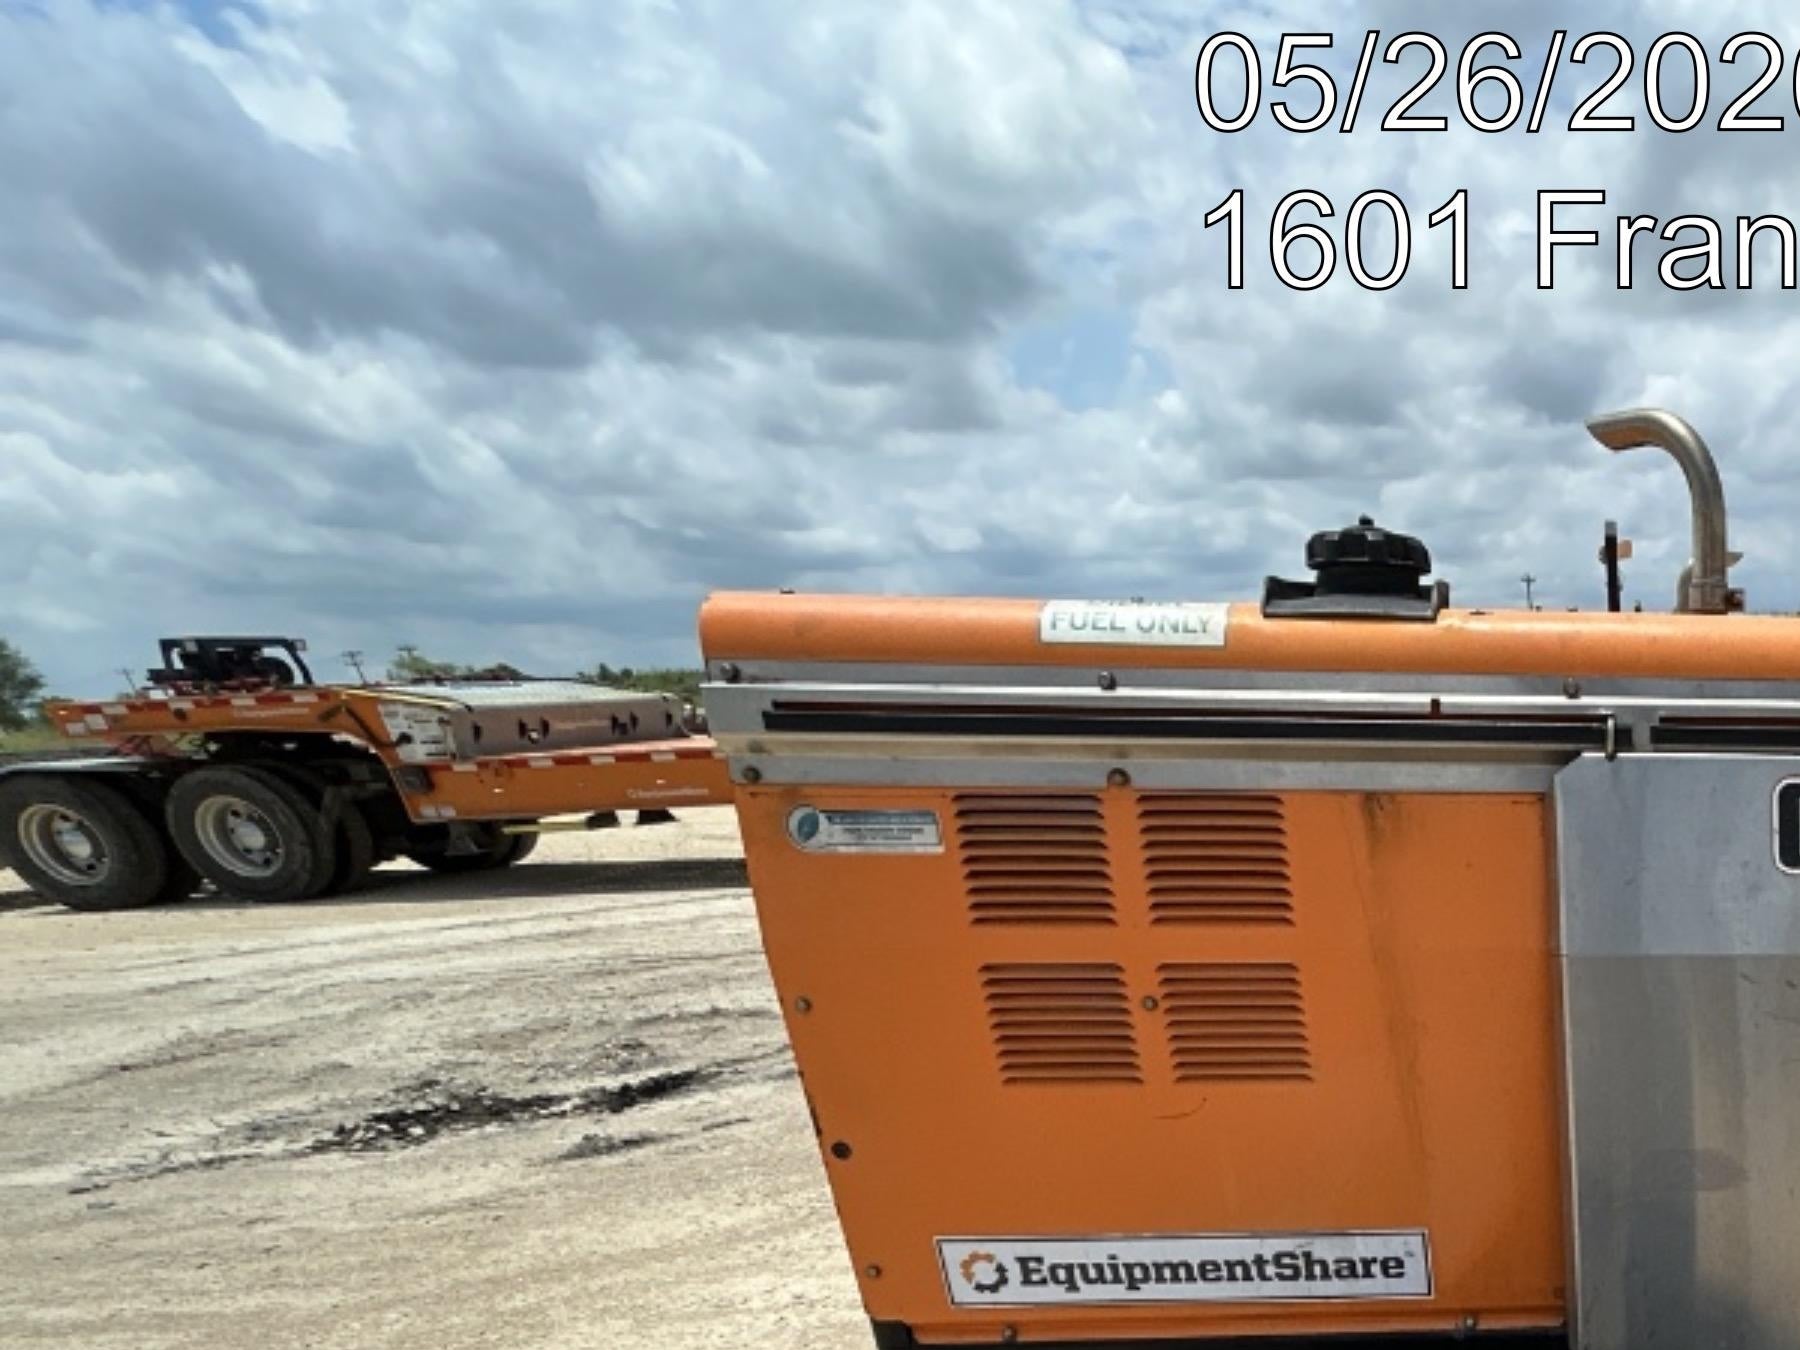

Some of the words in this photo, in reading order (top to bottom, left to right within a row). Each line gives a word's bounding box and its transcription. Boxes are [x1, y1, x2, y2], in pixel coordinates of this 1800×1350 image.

[1050, 610, 1126, 632] FUEL
[1135, 612, 1213, 635] ONLY
[1013, 1247, 1407, 1294] EquipmentShare
